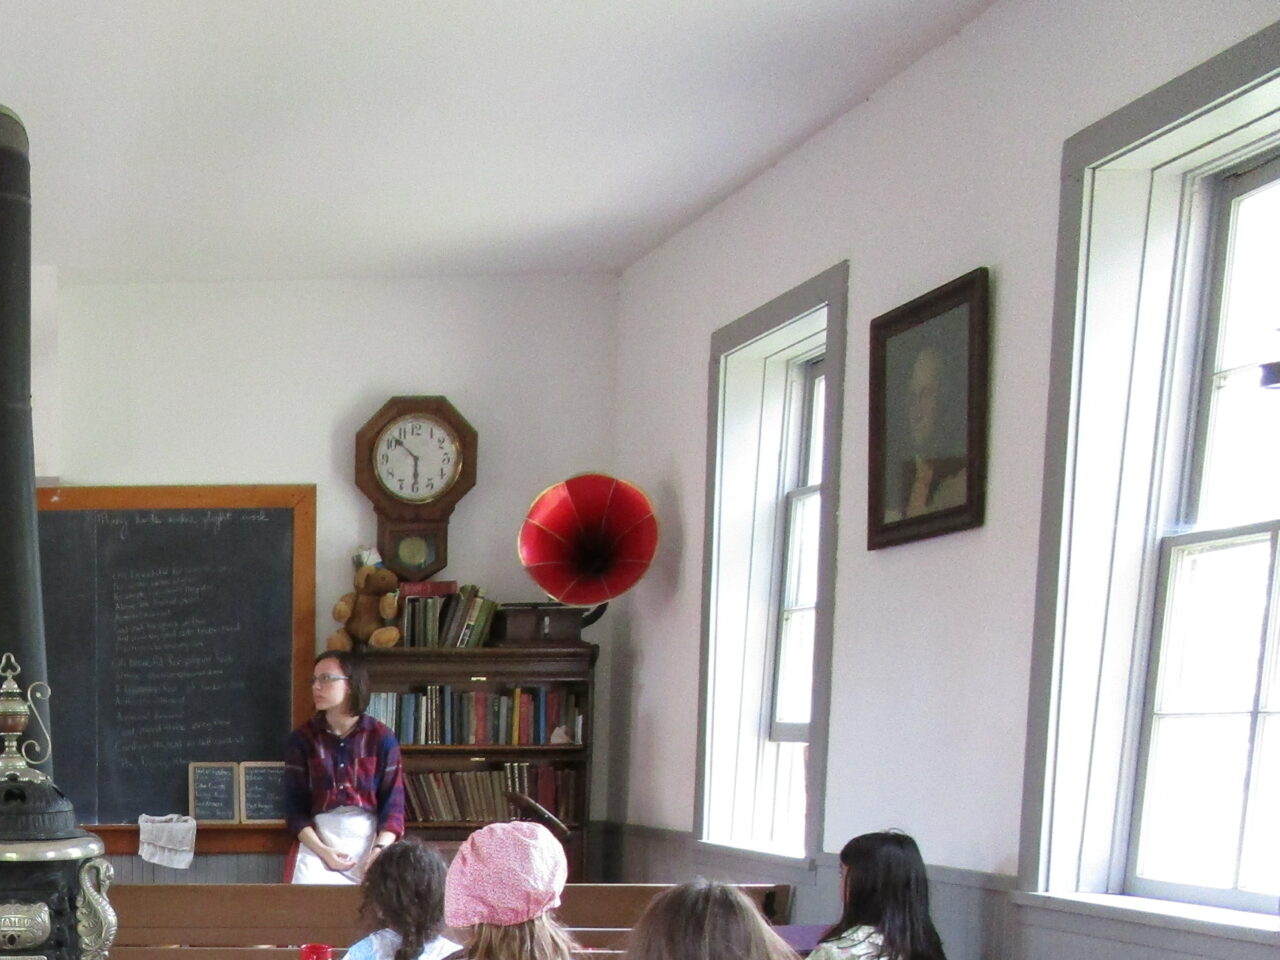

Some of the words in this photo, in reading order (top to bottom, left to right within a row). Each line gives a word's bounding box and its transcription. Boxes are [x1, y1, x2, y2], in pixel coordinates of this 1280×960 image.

[399, 427, 407, 440] 11
[410, 424, 422, 436] 12
[429, 427, 434, 439] 1
[437, 437, 446, 449] 2
[381, 454, 389, 465] 9
[442, 452, 451, 464] 3
[387, 469, 395, 478] 8
[440, 467, 447, 480] 4
[398, 479, 405, 491] 7
[411, 480, 419, 493] 6
[426, 478, 435, 490] 5
